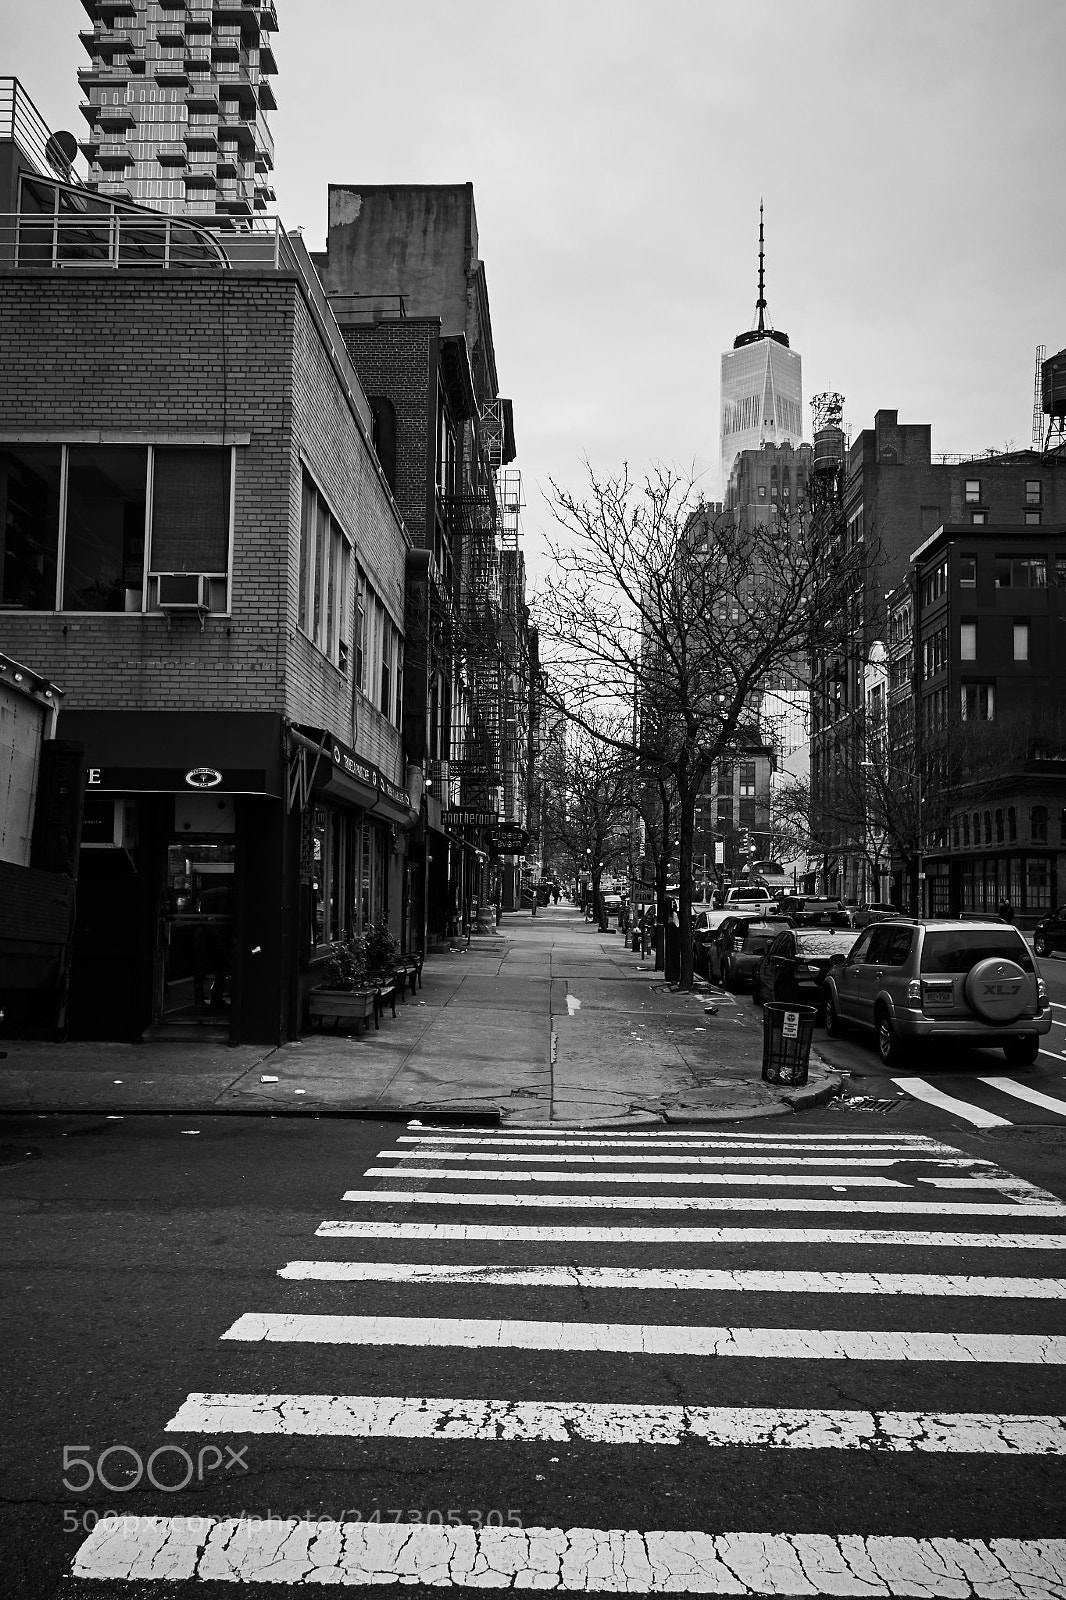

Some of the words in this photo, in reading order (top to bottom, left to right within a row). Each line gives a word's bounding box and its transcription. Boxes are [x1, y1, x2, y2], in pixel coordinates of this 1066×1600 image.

[441, 811, 497, 825] anotheroom
[490, 830, 524, 840] Tribeca
[491, 838, 522, 848] Tavern
